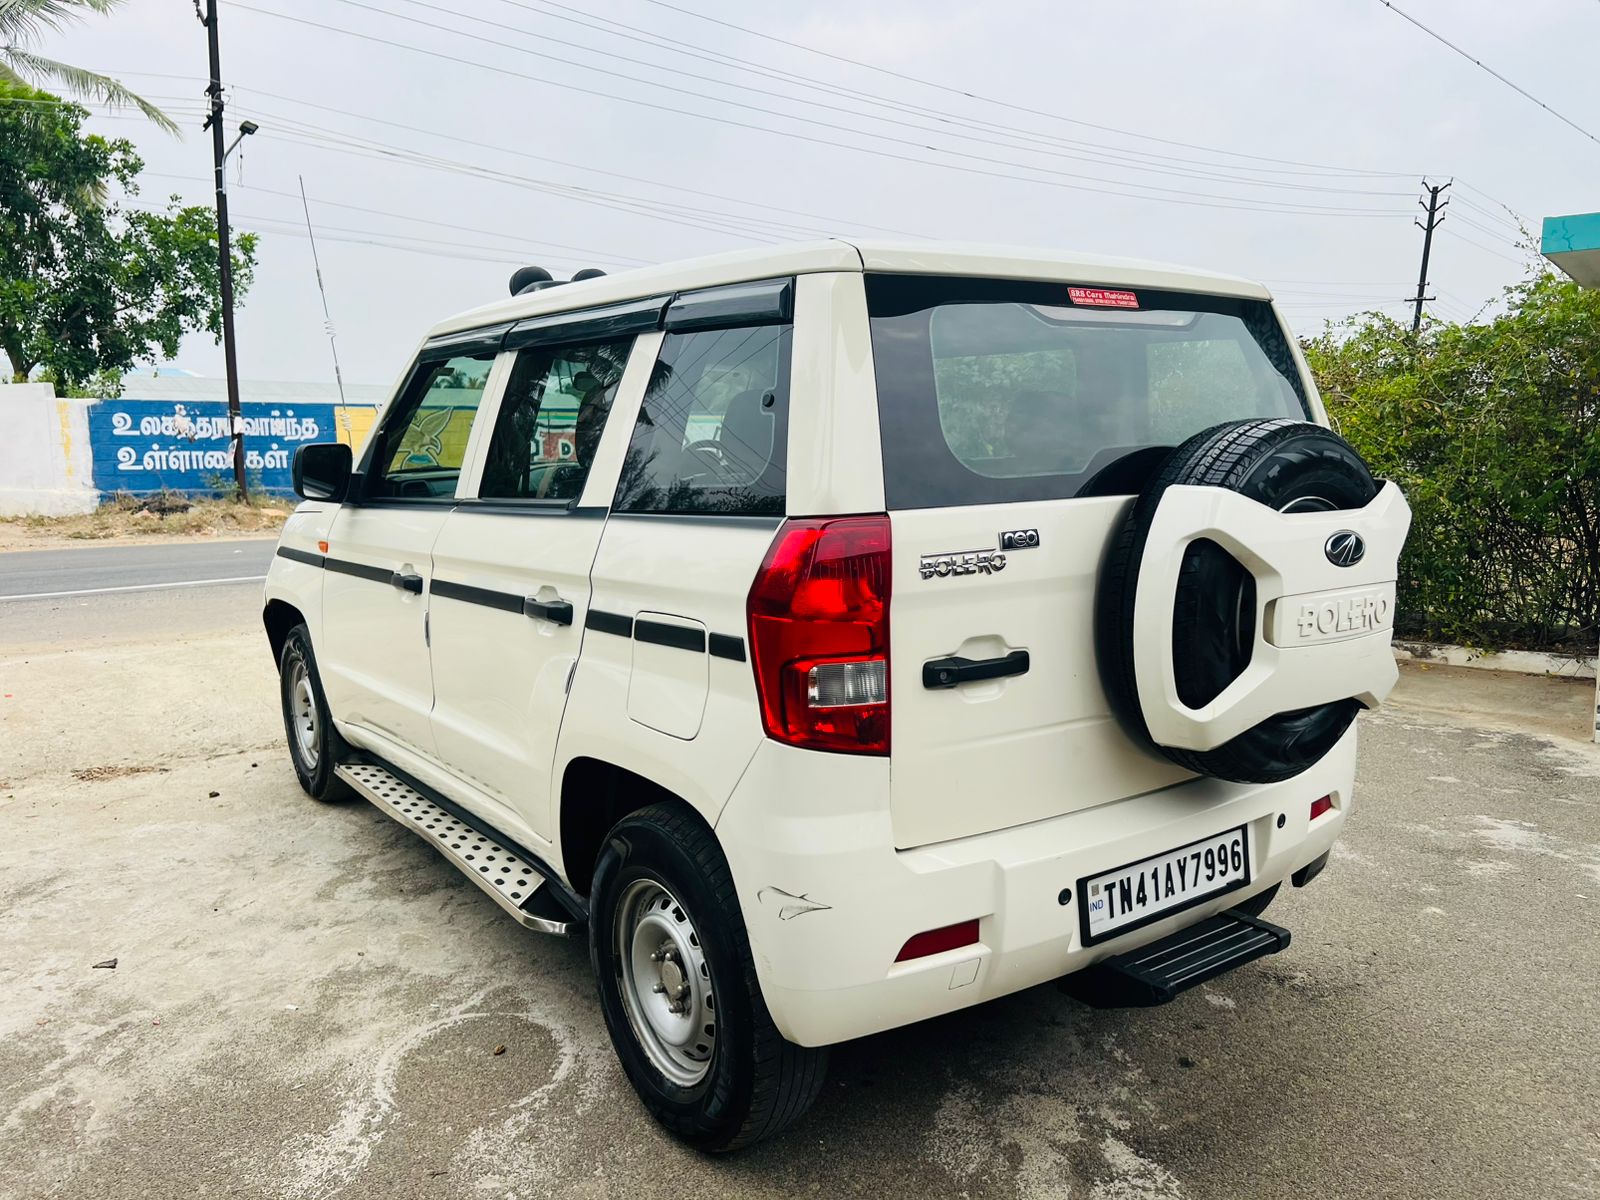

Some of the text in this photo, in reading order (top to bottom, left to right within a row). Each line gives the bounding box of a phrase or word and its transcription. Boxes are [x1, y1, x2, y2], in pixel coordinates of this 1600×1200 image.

[1086, 291, 1103, 299] Cars
[1104, 292, 1135, 301] Mahindra
[919, 551, 1007, 580] BOLERO
[1297, 595, 1387, 637] BOLERO
[1089, 839, 1242, 919] IND TN41AY7996
